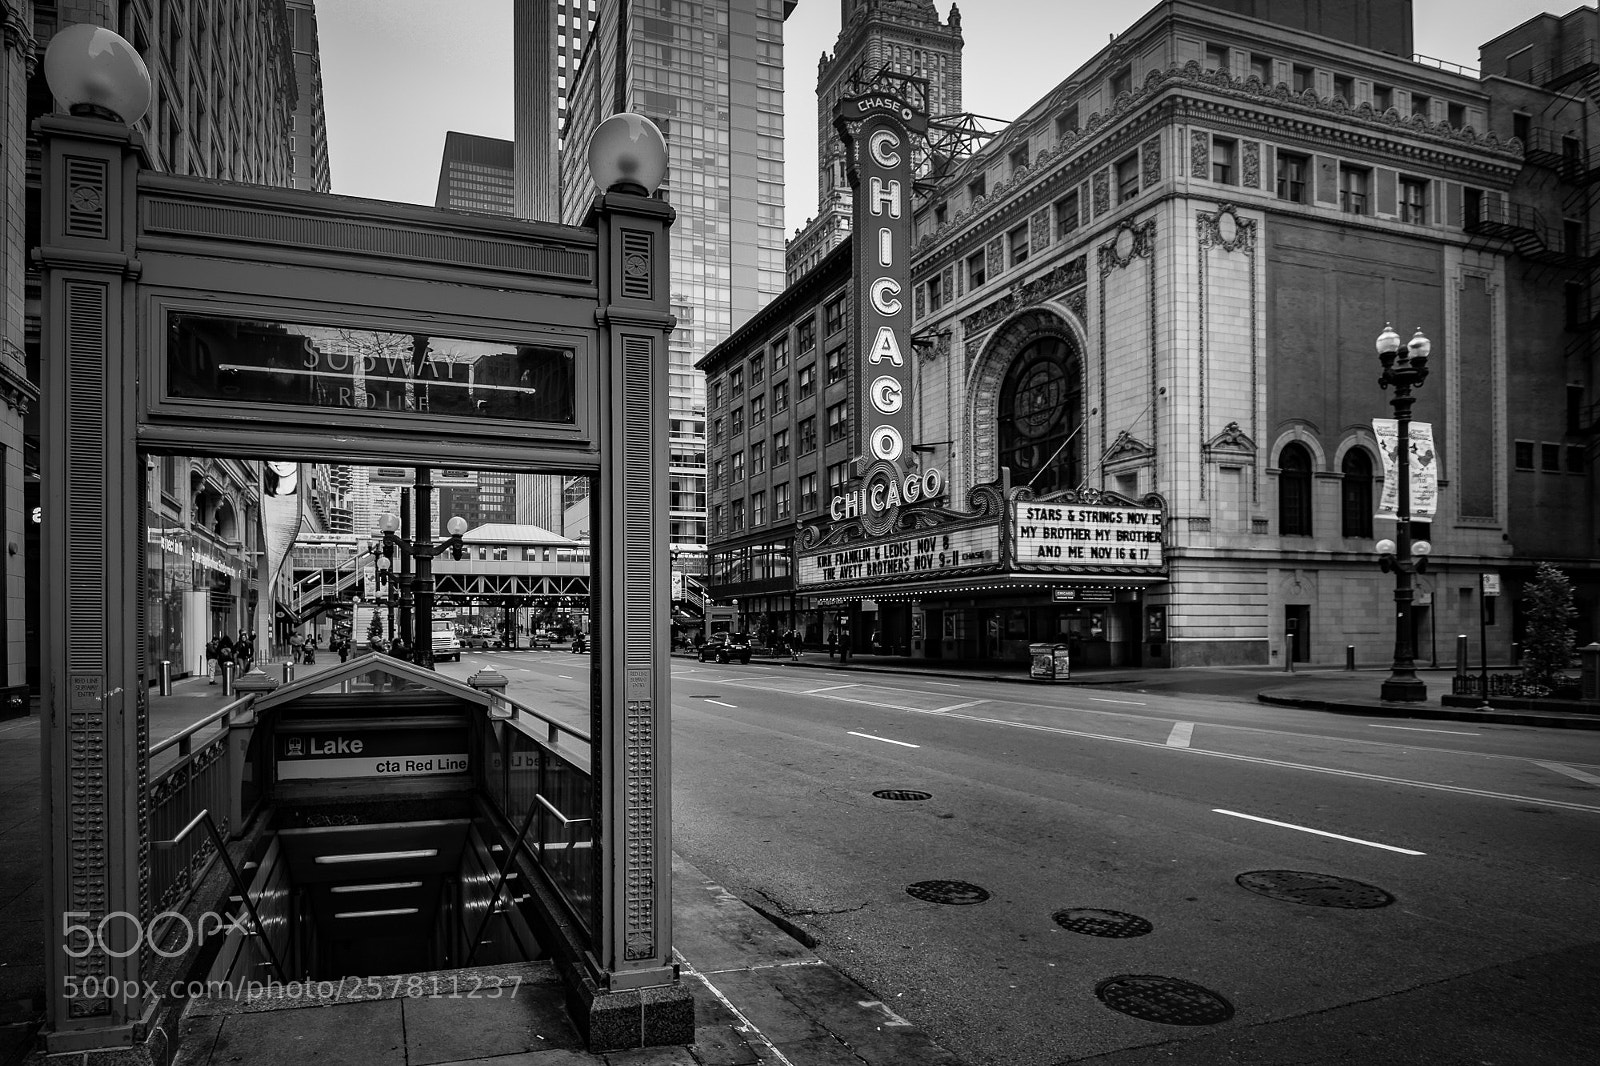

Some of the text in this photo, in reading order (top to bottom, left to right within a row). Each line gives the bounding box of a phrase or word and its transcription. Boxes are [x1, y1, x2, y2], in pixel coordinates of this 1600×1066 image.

[858, 98, 901, 113] CHASE
[868, 129, 903, 462] CHICAGO
[303, 337, 457, 379] SUBWAY
[339, 386, 376, 409] RD
[830, 467, 941, 521] CHICAGO
[1026, 507, 1161, 525] STARS & STRINGS NOV 15
[1020, 526, 1161, 543] MY BROTHER MY BROTHER
[835, 547, 870, 566] FRANKLIN
[883, 541, 911, 559] LEDISI
[917, 536, 936, 554] NOV
[942, 535, 949, 550] 8
[962, 551, 984, 560] CHASE
[1038, 545, 1149, 560] AND ME NOV 16 & 17
[823, 567, 835, 580] THE
[866, 557, 910, 576] BROTHERS
[914, 553, 933, 571] NOV
[939, 550, 958, 567] 9-11
[310, 736, 364, 755] Lake
[376, 758, 467, 773] cta Red Line
